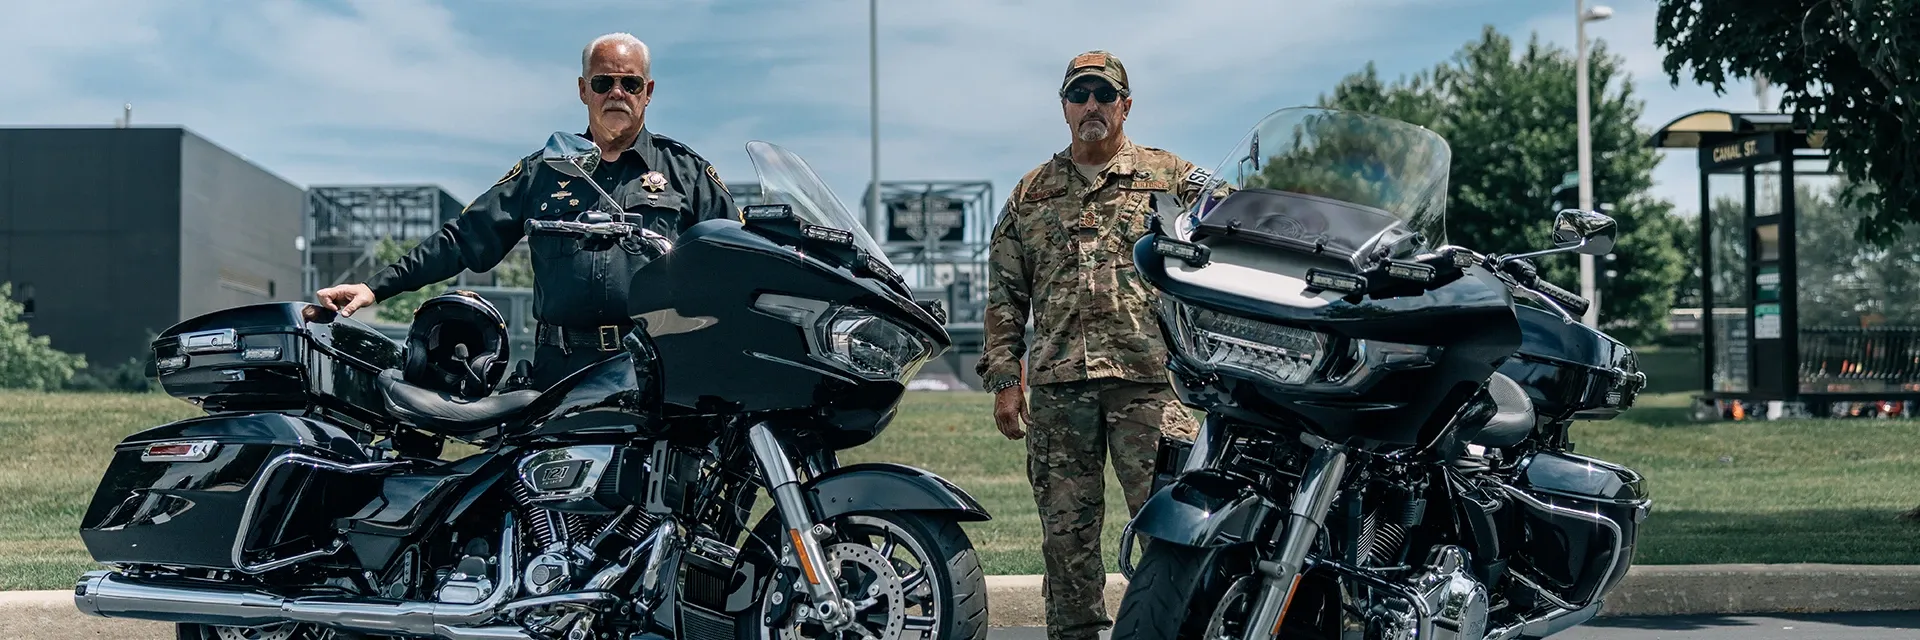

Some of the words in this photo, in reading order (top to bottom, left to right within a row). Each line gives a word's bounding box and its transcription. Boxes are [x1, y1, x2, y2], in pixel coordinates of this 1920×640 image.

[1713, 144, 1742, 163] CANAL
[1744, 140, 1759, 157] ST.
[542, 465, 570, 481] 121
